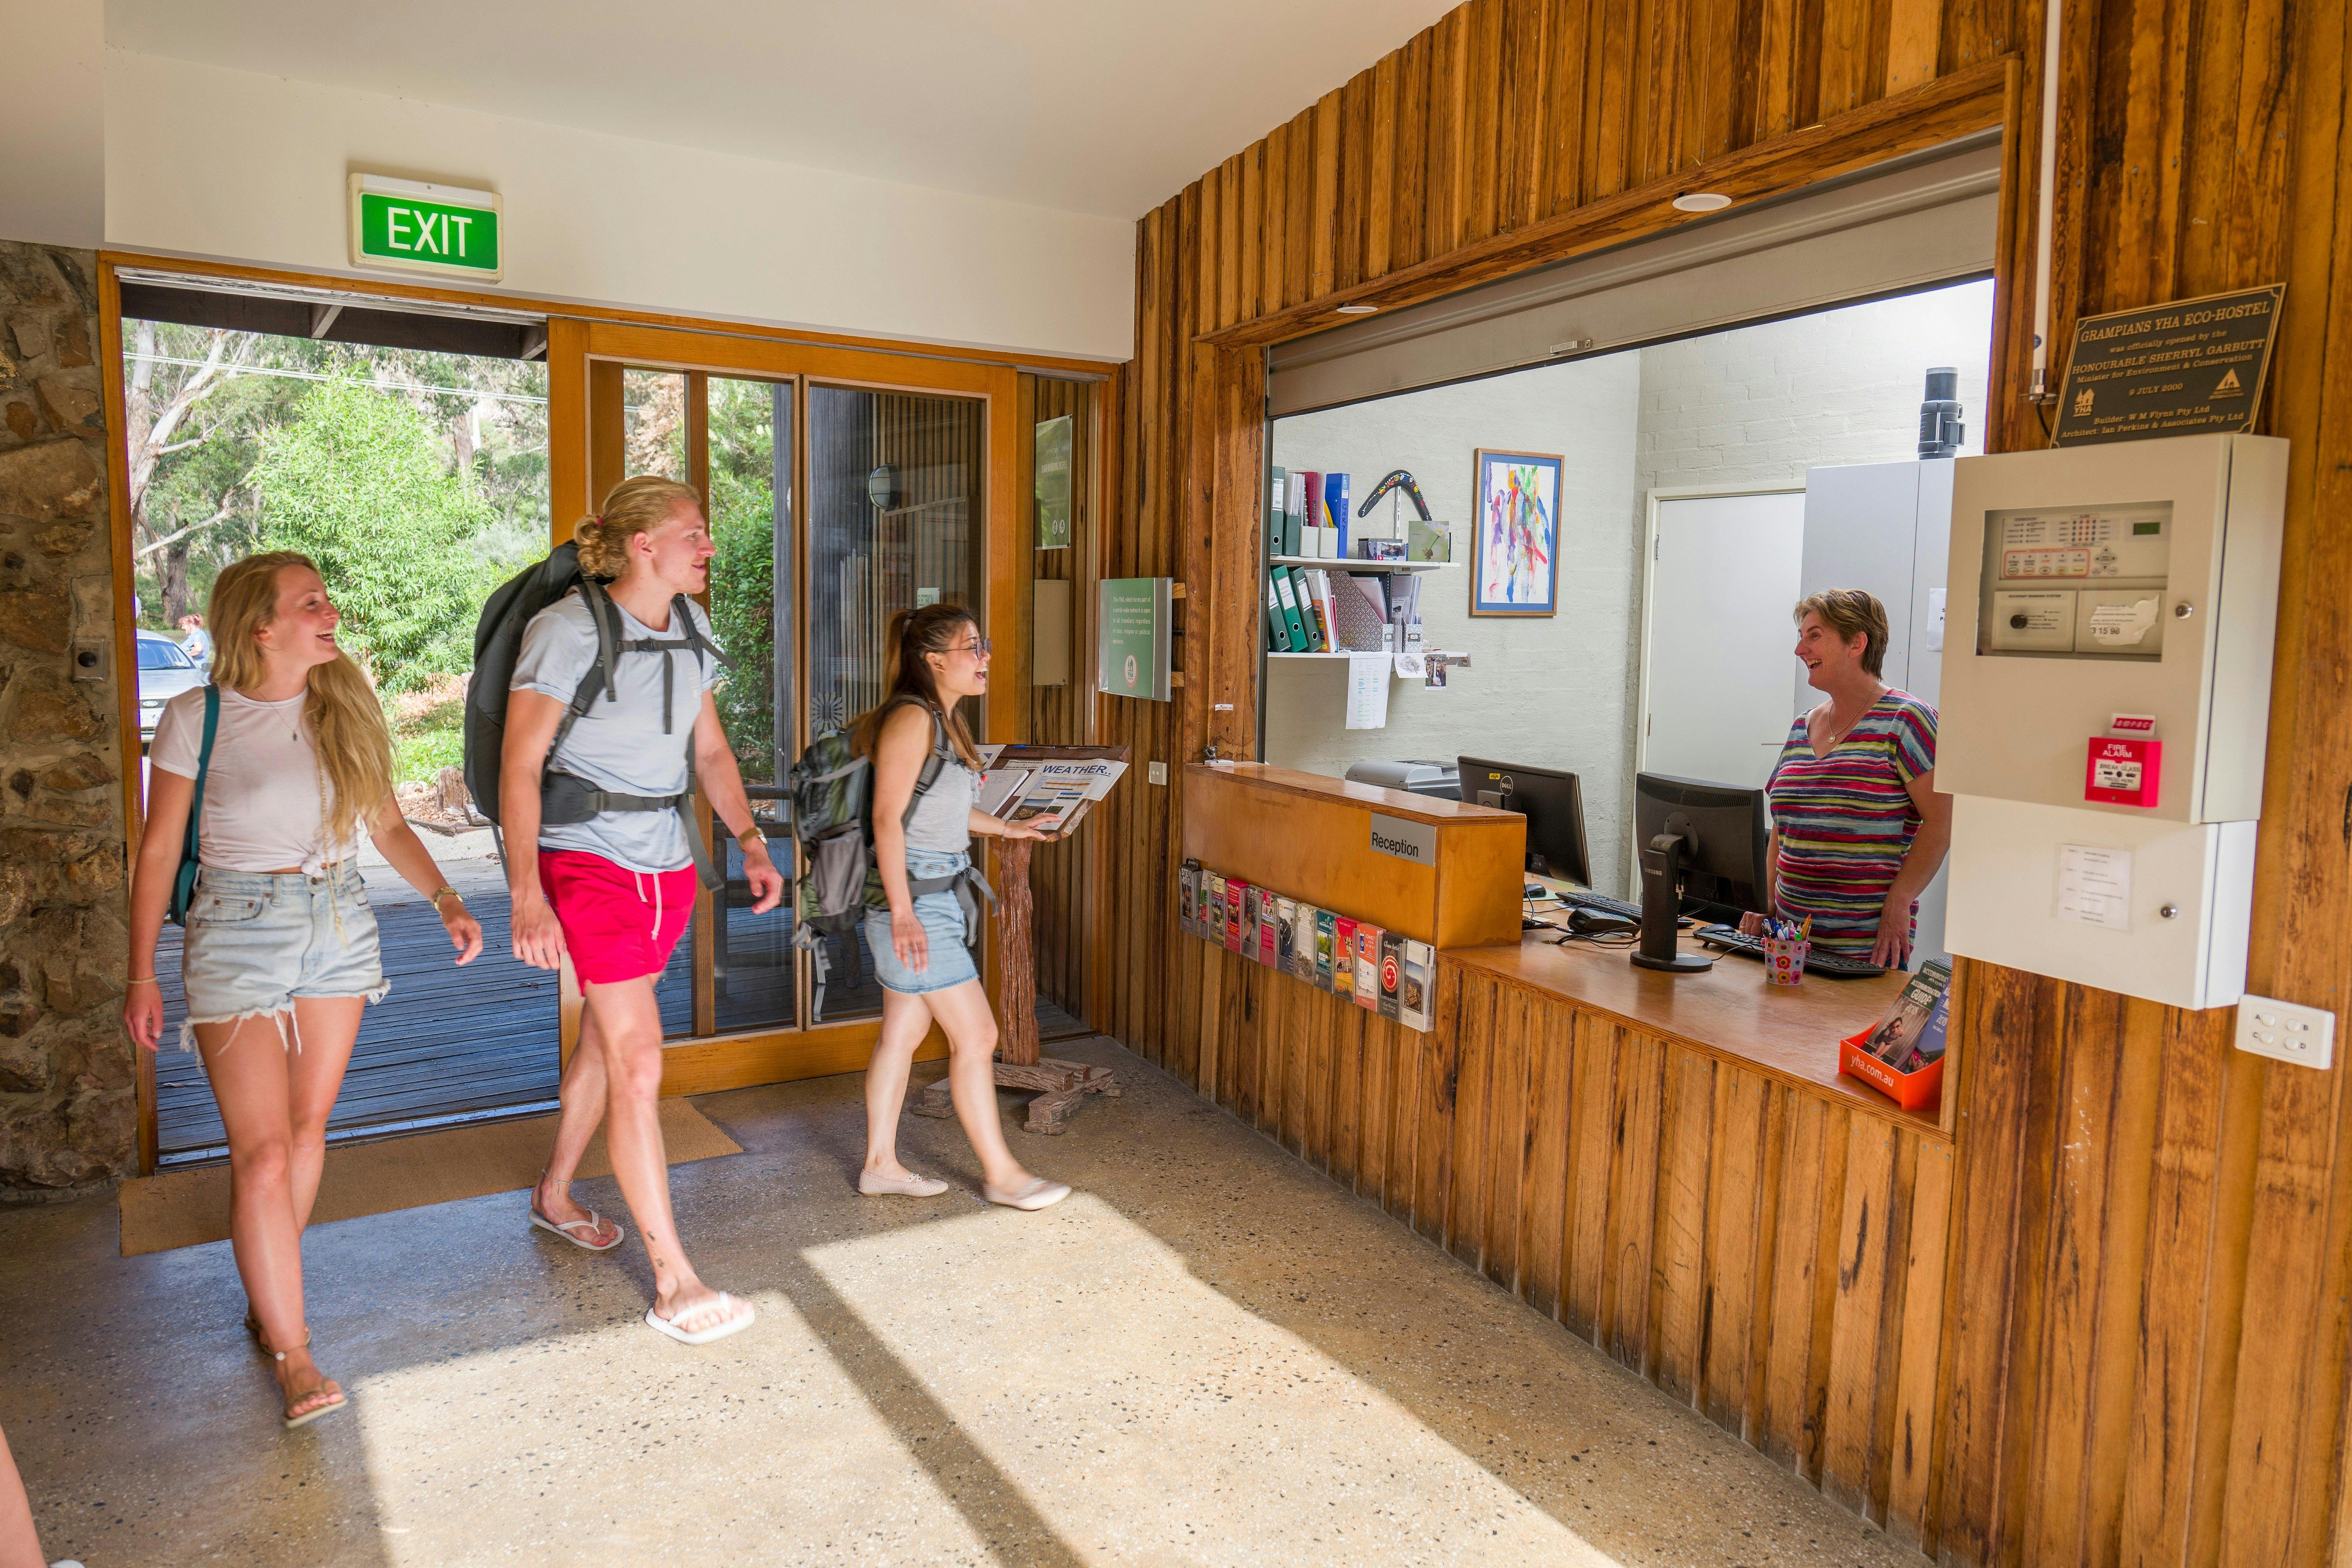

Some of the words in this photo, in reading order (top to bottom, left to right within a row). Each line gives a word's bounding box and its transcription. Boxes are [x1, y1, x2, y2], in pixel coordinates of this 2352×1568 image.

[387, 206, 472, 258] EXIT
[2080, 320, 2152, 343] GRAMPIANS
[2155, 316, 2180, 330] YHA
[2183, 301, 2271, 326] ECO-HOSTEL
[2127, 339, 2163, 351] officially
[2165, 334, 2196, 346] opened
[2212, 330, 2227, 338] the
[2071, 355, 2147, 375] HONOURABLE
[2149, 348, 2203, 363] SHERRYL
[2206, 339, 2265, 355] GARBUTT
[2077, 373, 2110, 383] Minister
[2126, 364, 2181, 377] Environment
[2183, 361, 2191, 369] &
[2193, 354, 2253, 368] Conservation
[2136, 385, 2160, 396] JULY
[2161, 383, 2184, 392] 2000
[2074, 405, 2092, 414] YHA
[2139, 412, 2148, 420] M
[2150, 411, 2174, 419] Flynn
[2194, 405, 2210, 414] Ltd
[2117, 423, 2150, 432] Perkins
[2160, 417, 2207, 428] Associates
[2209, 415, 2225, 423] Pty
[2227, 412, 2244, 421] Ltd
[2102, 750, 2132, 759] ALARM
[1372, 831, 1419, 858] Reception
[1644, 867, 1662, 876] SAMSUNG
[1850, 1054, 1894, 1088] yha.com.au
